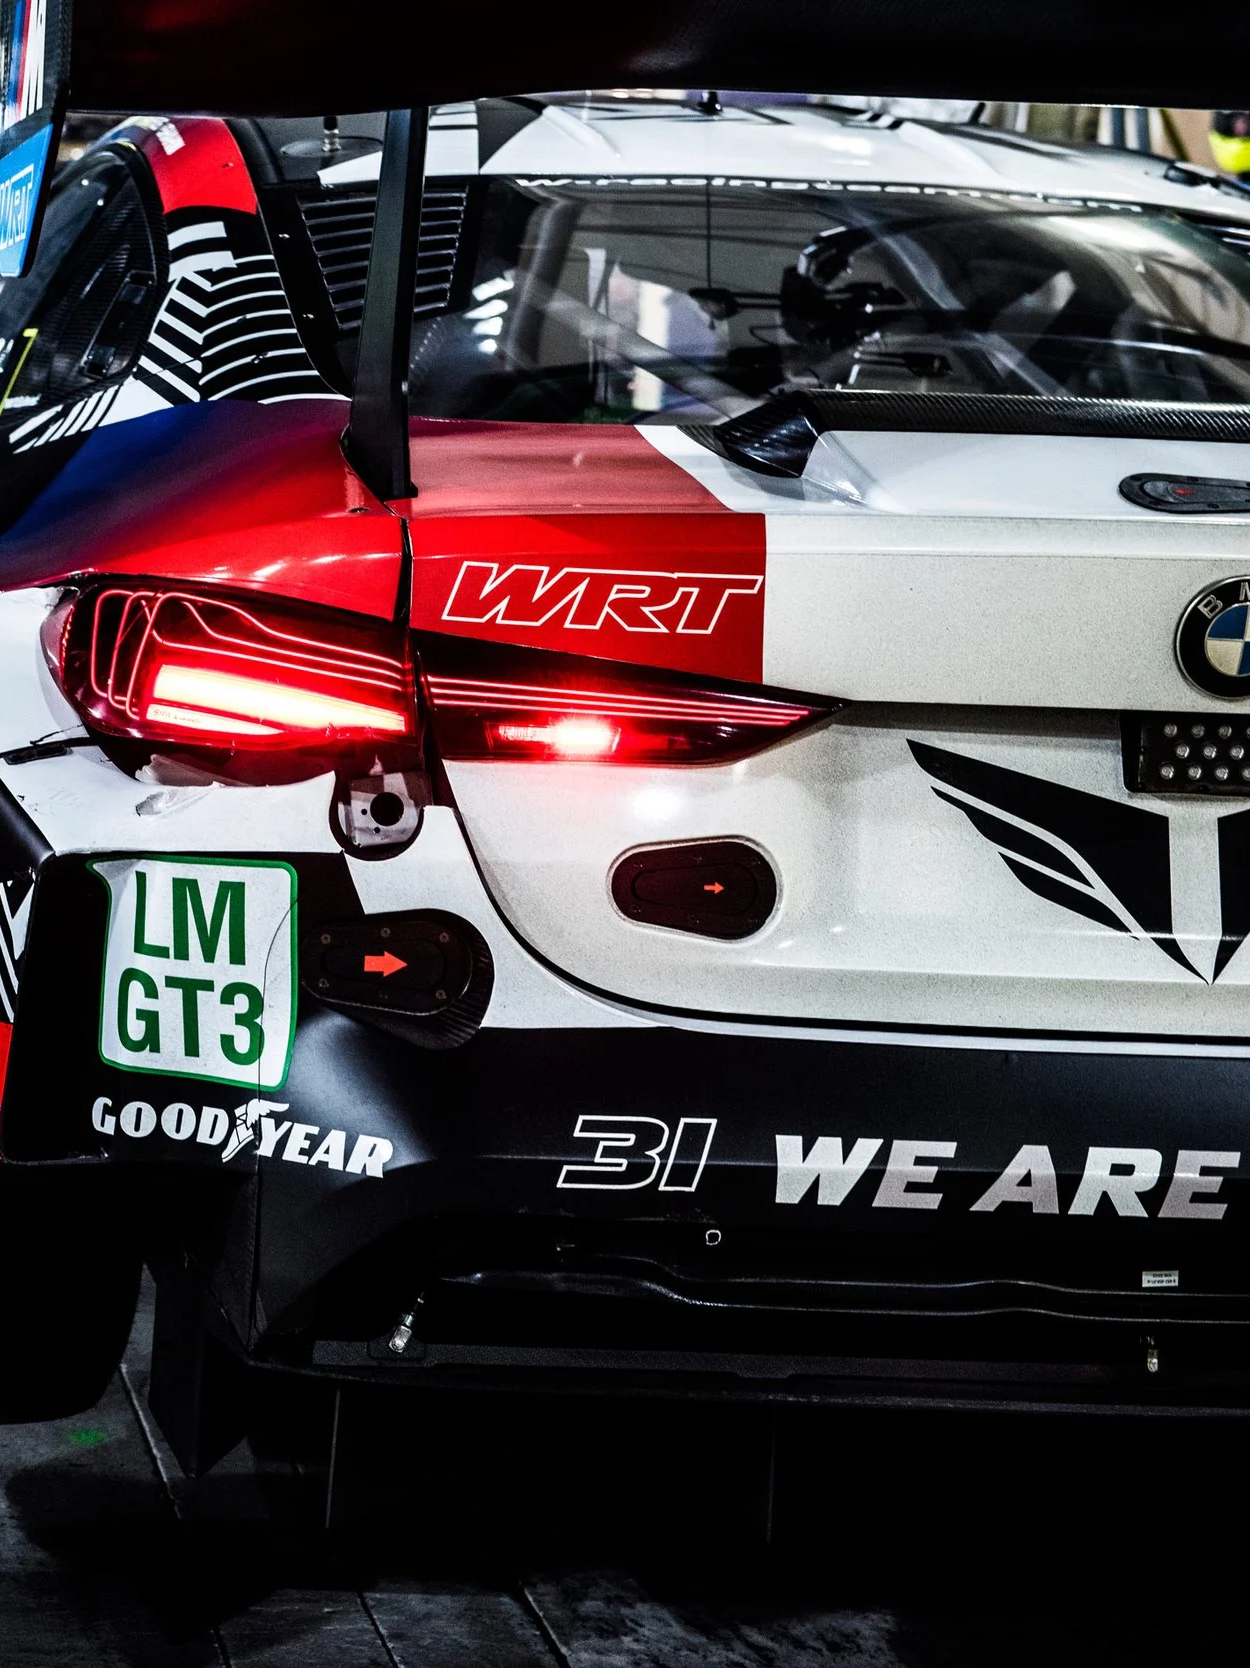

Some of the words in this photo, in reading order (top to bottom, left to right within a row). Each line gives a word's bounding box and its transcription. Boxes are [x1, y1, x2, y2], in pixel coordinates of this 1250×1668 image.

[441, 561, 764, 635] WRT
[133, 870, 247, 966] LM
[116, 968, 266, 1066] GT3
[557, 1114, 718, 1192] 31
[775, 1134, 957, 1210] WE
[969, 1144, 1241, 1221] ARE
